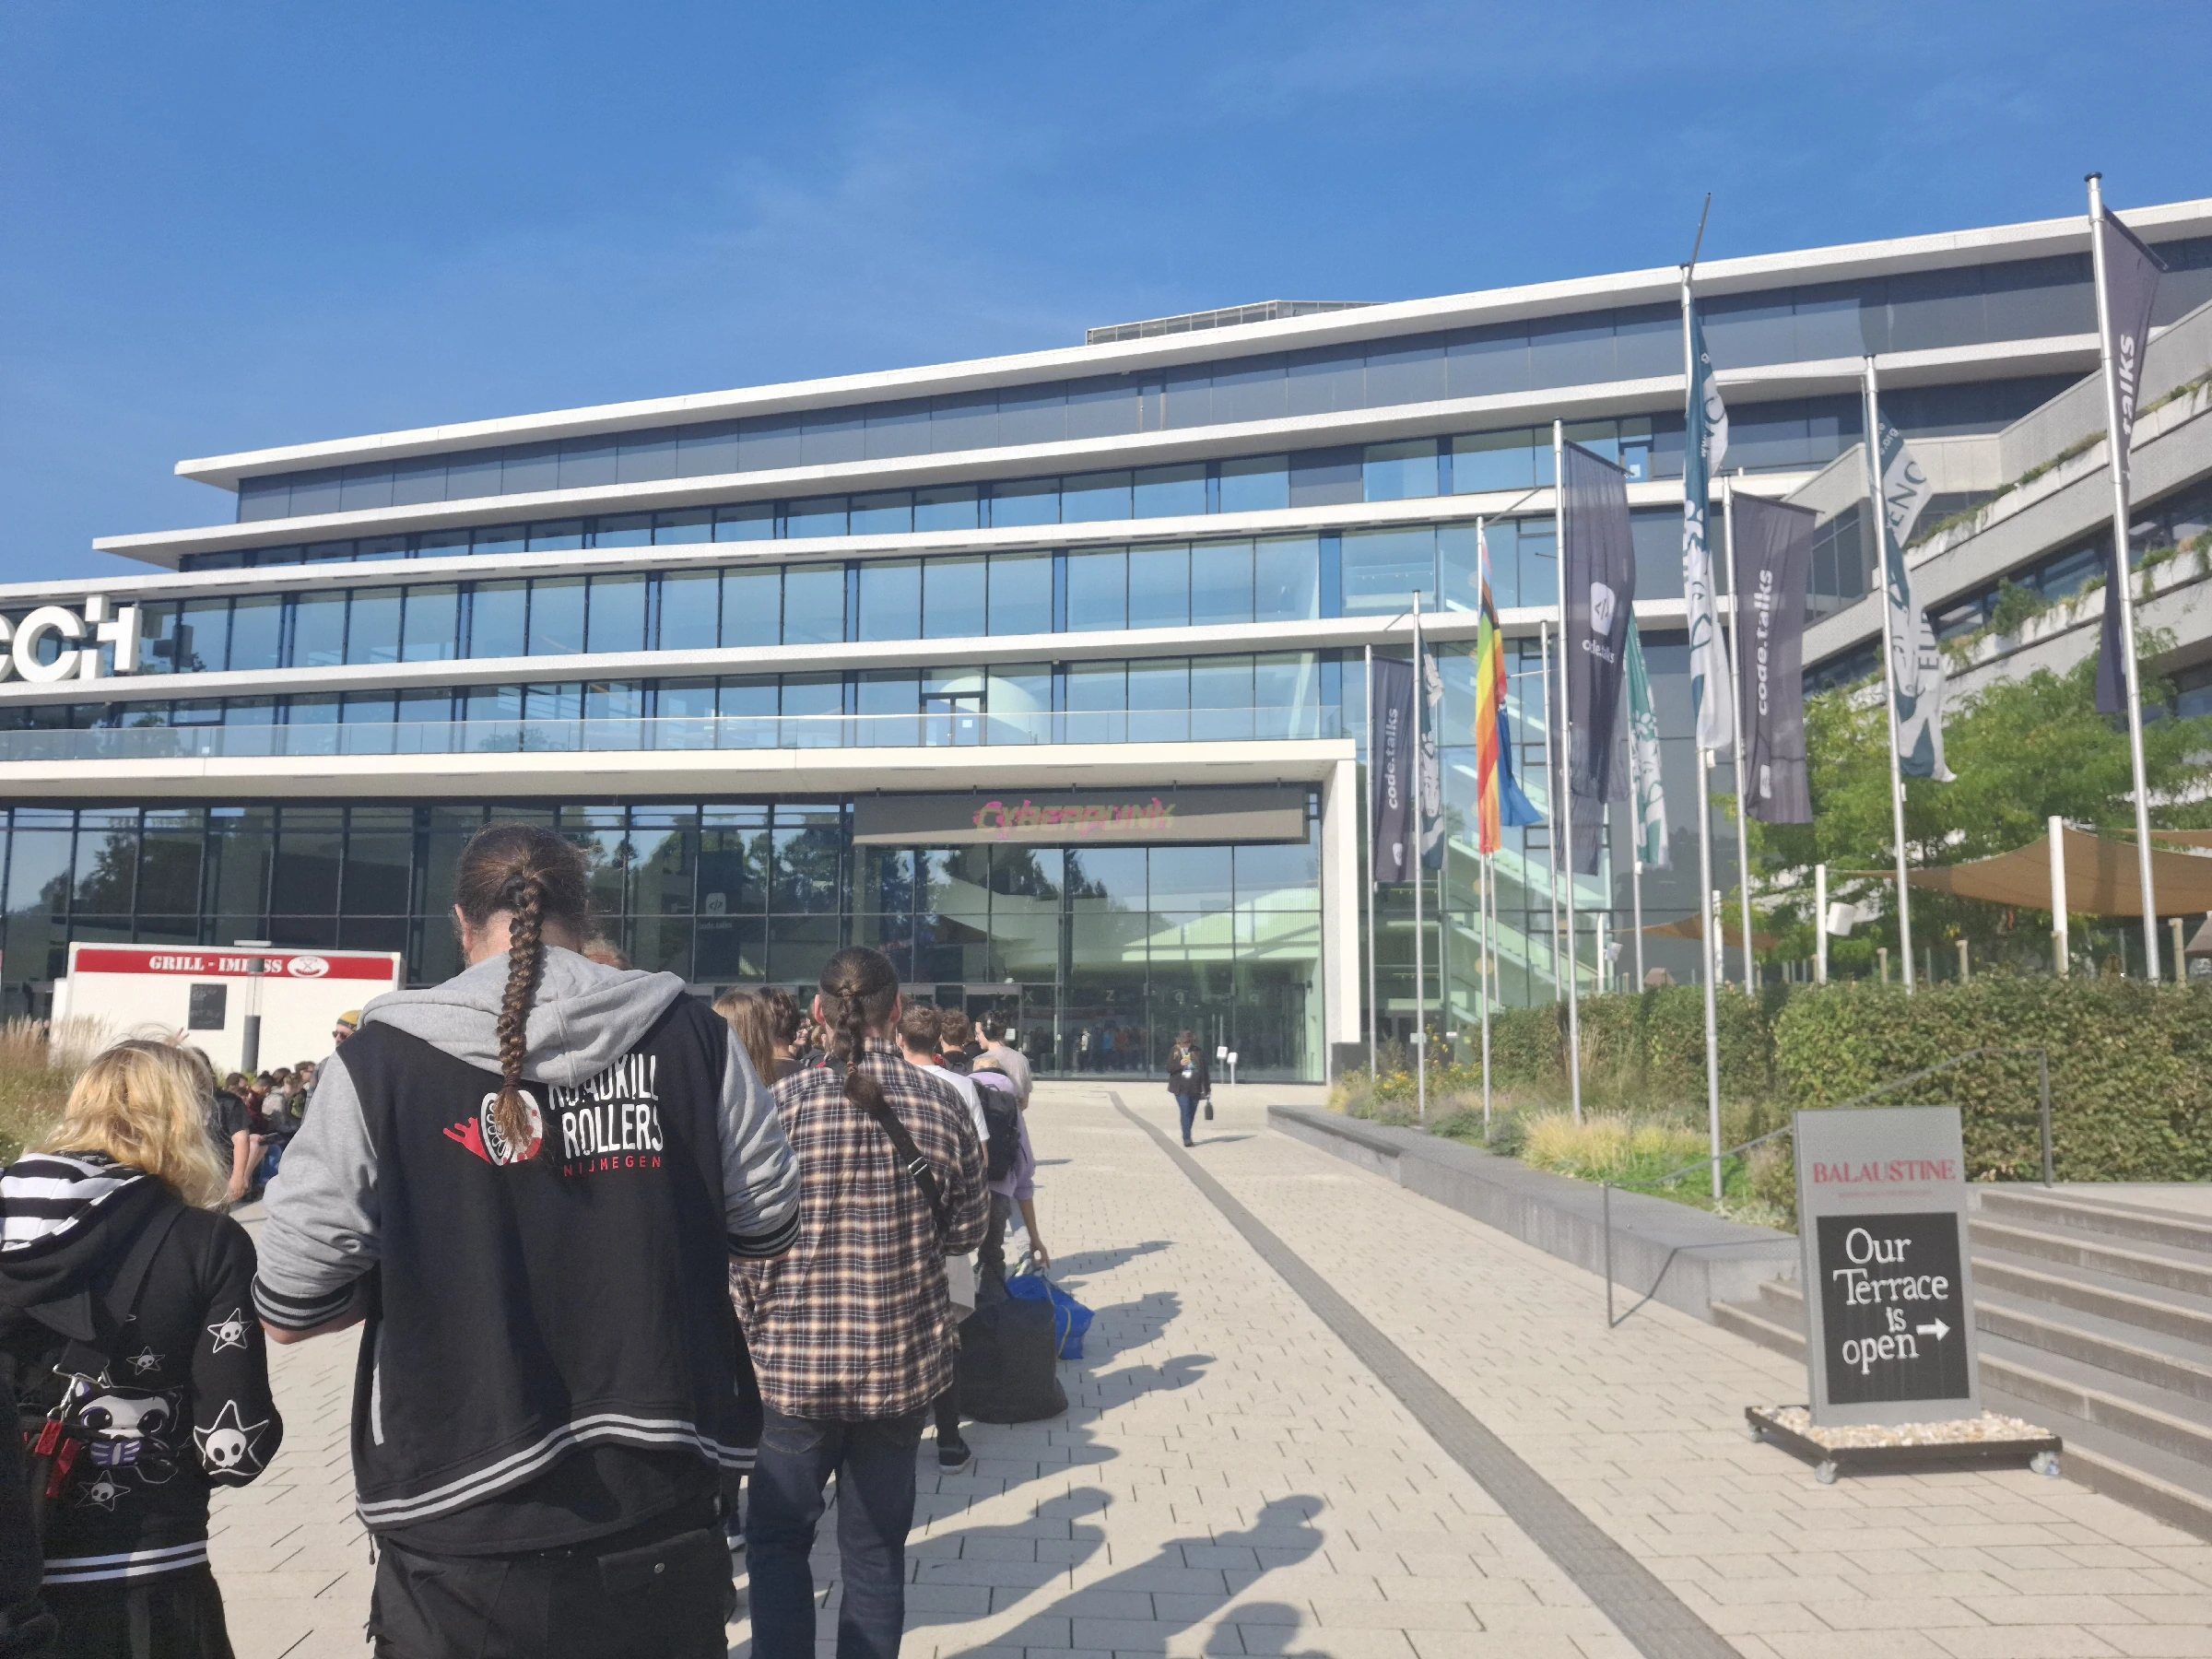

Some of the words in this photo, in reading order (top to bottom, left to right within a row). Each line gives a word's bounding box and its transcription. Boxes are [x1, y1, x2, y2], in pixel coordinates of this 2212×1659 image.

[0, 594, 142, 683] CH
[1754, 570, 1772, 716] code.talks
[1384, 708, 1399, 809] code.talks
[148, 955, 205, 971] GRILL
[561, 1104, 664, 1159] ROLLERS
[563, 1155, 661, 1177] NIJMEGEN
[1813, 1159, 1957, 1183] BALAUSTINE
[1845, 1228, 1912, 1265] Our
[1832, 1268, 1949, 1305] Terrace
[1841, 1334, 1920, 1375] open
